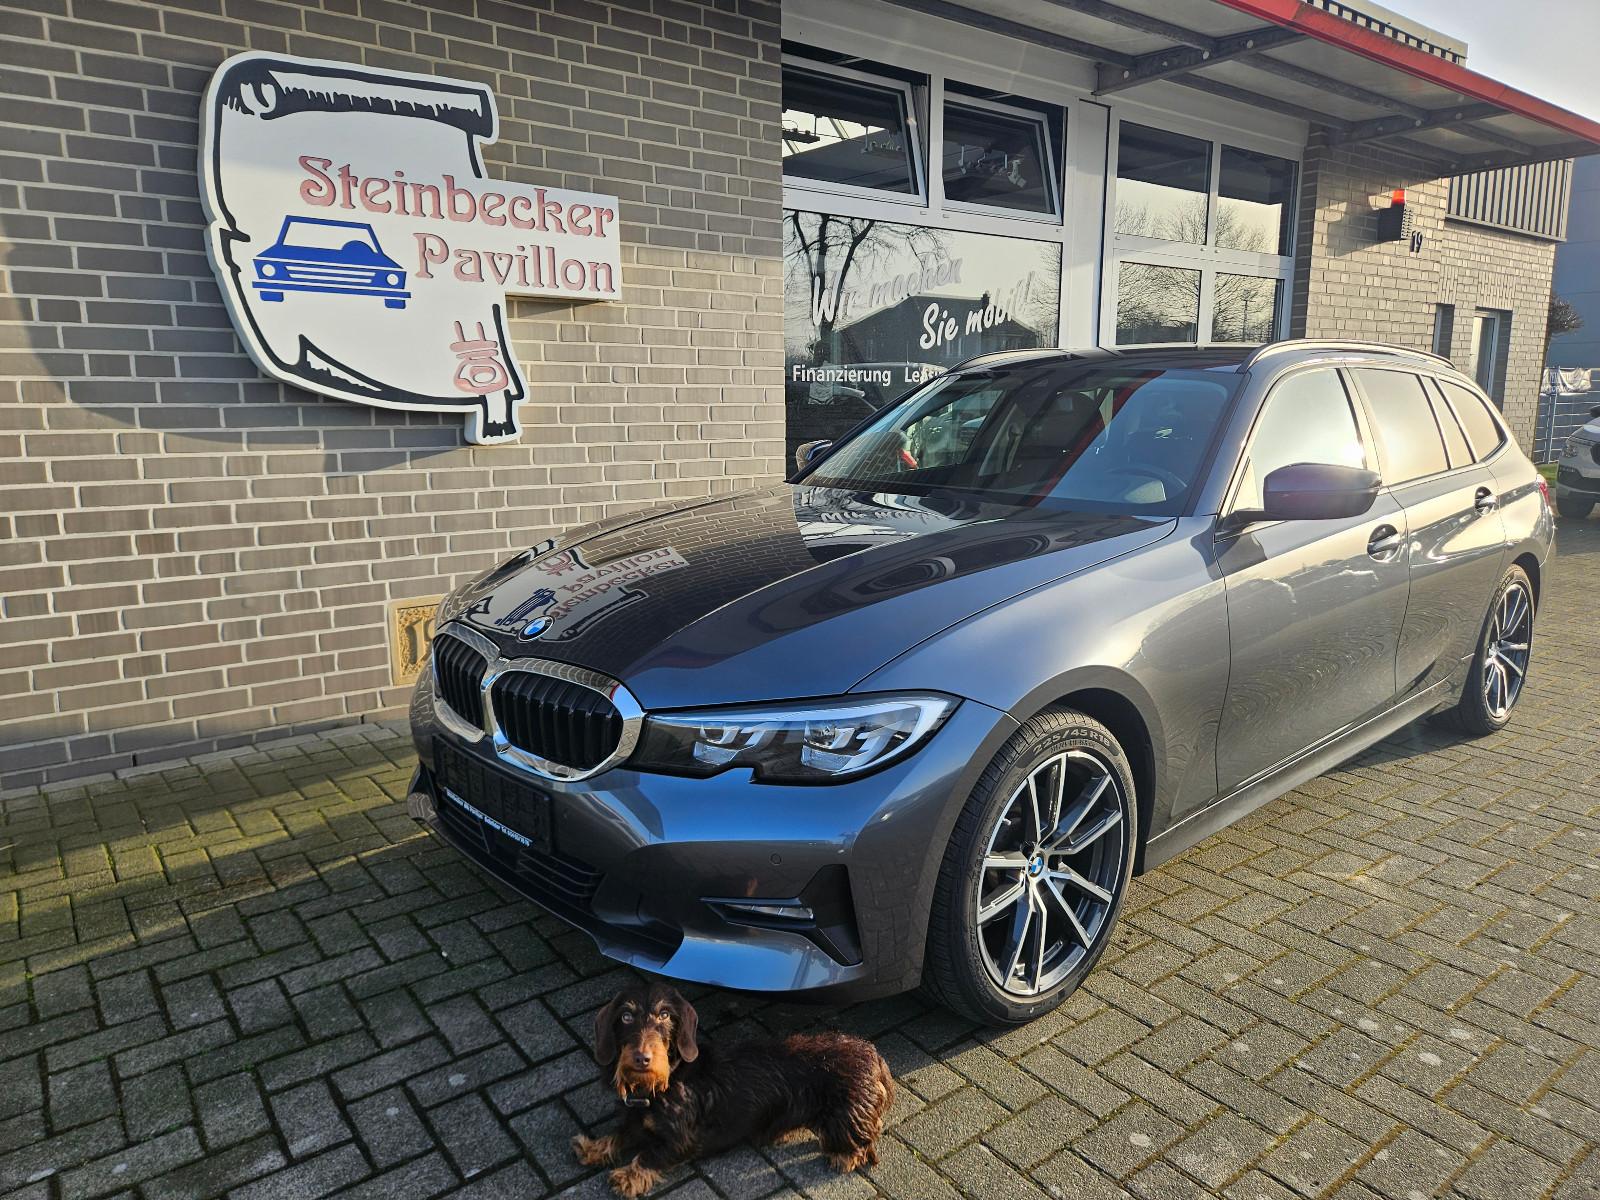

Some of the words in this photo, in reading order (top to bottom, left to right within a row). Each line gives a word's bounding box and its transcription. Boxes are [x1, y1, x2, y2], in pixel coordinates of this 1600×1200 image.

[299, 155, 615, 238] Steinbecker
[413, 232, 617, 294] Pavillon
[1409, 230, 1423, 253] 19
[812, 271, 858, 326] Wir
[869, 253, 963, 308] machen
[919, 302, 959, 350] Sie
[791, 364, 891, 387] Finanzierung
